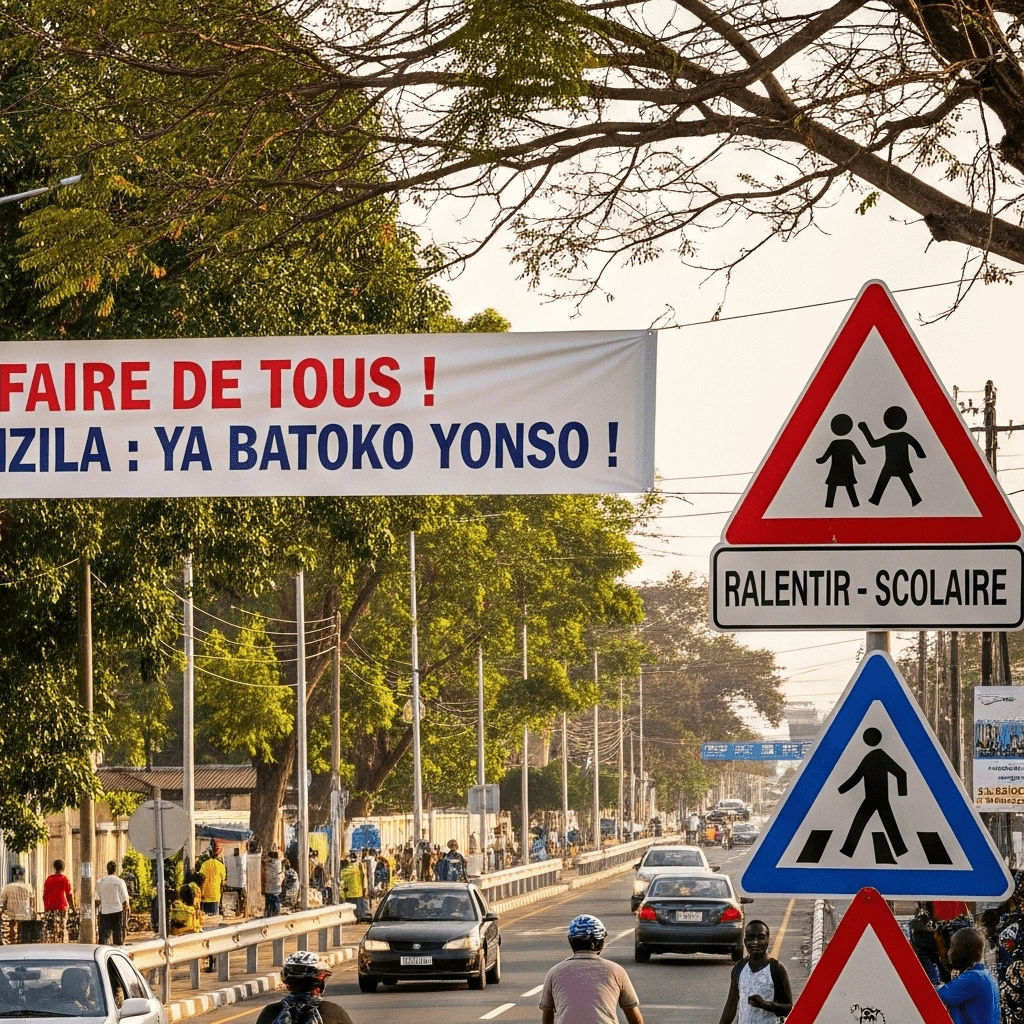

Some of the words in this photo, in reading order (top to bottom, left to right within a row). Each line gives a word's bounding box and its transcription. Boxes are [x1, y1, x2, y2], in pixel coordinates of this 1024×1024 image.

[173, 359, 242, 411] DE
[260, 356, 401, 409] TOUS
[423, 356, 436, 407] !
[129, 440, 139, 472] :
[156, 425, 211, 472] YA
[230, 422, 413, 471] BATOKO
[430, 421, 589, 470] YONSO
[608, 421, 619, 468] !
[725, 569, 851, 607] RALENTIR
[874, 568, 1008, 606] SCOLAIRE
